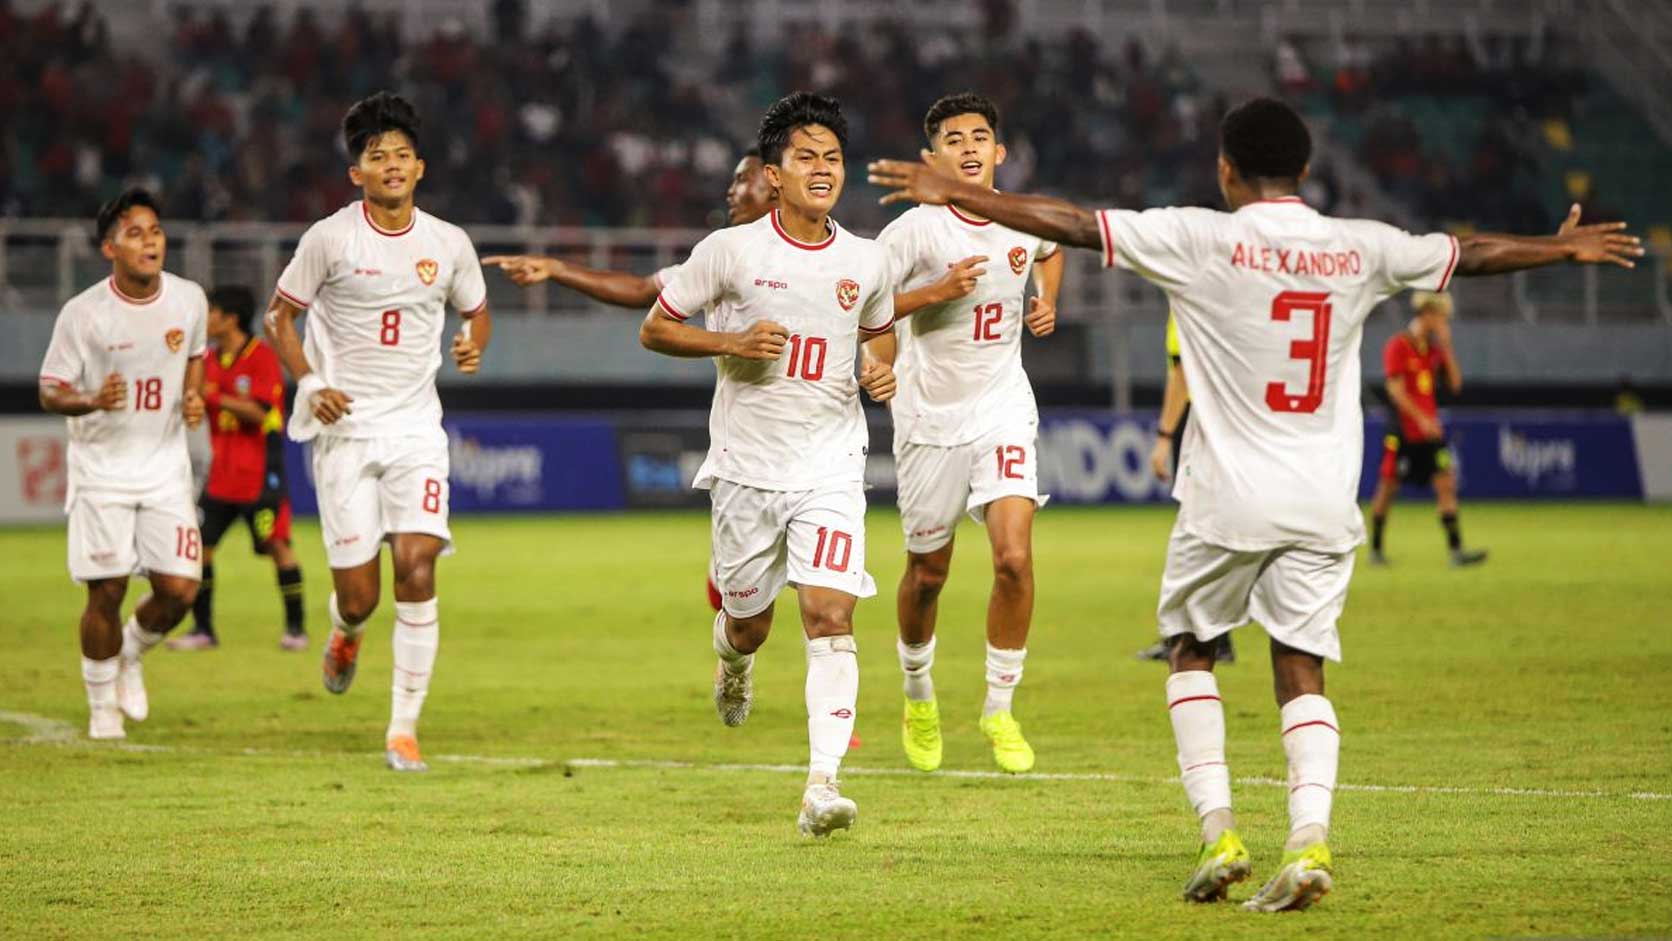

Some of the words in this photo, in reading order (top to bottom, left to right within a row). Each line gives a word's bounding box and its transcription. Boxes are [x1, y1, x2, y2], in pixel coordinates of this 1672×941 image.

[1231, 242, 1361, 276] ALEXANDRO
[381, 310, 401, 346] 8
[973, 302, 1003, 341] 12
[786, 334, 827, 381] 10
[1265, 290, 1332, 413] 3
[135, 378, 163, 412] 18
[995, 444, 1026, 480] 12
[423, 478, 440, 513] 8
[176, 526, 199, 561] 18
[812, 526, 852, 573] 10
